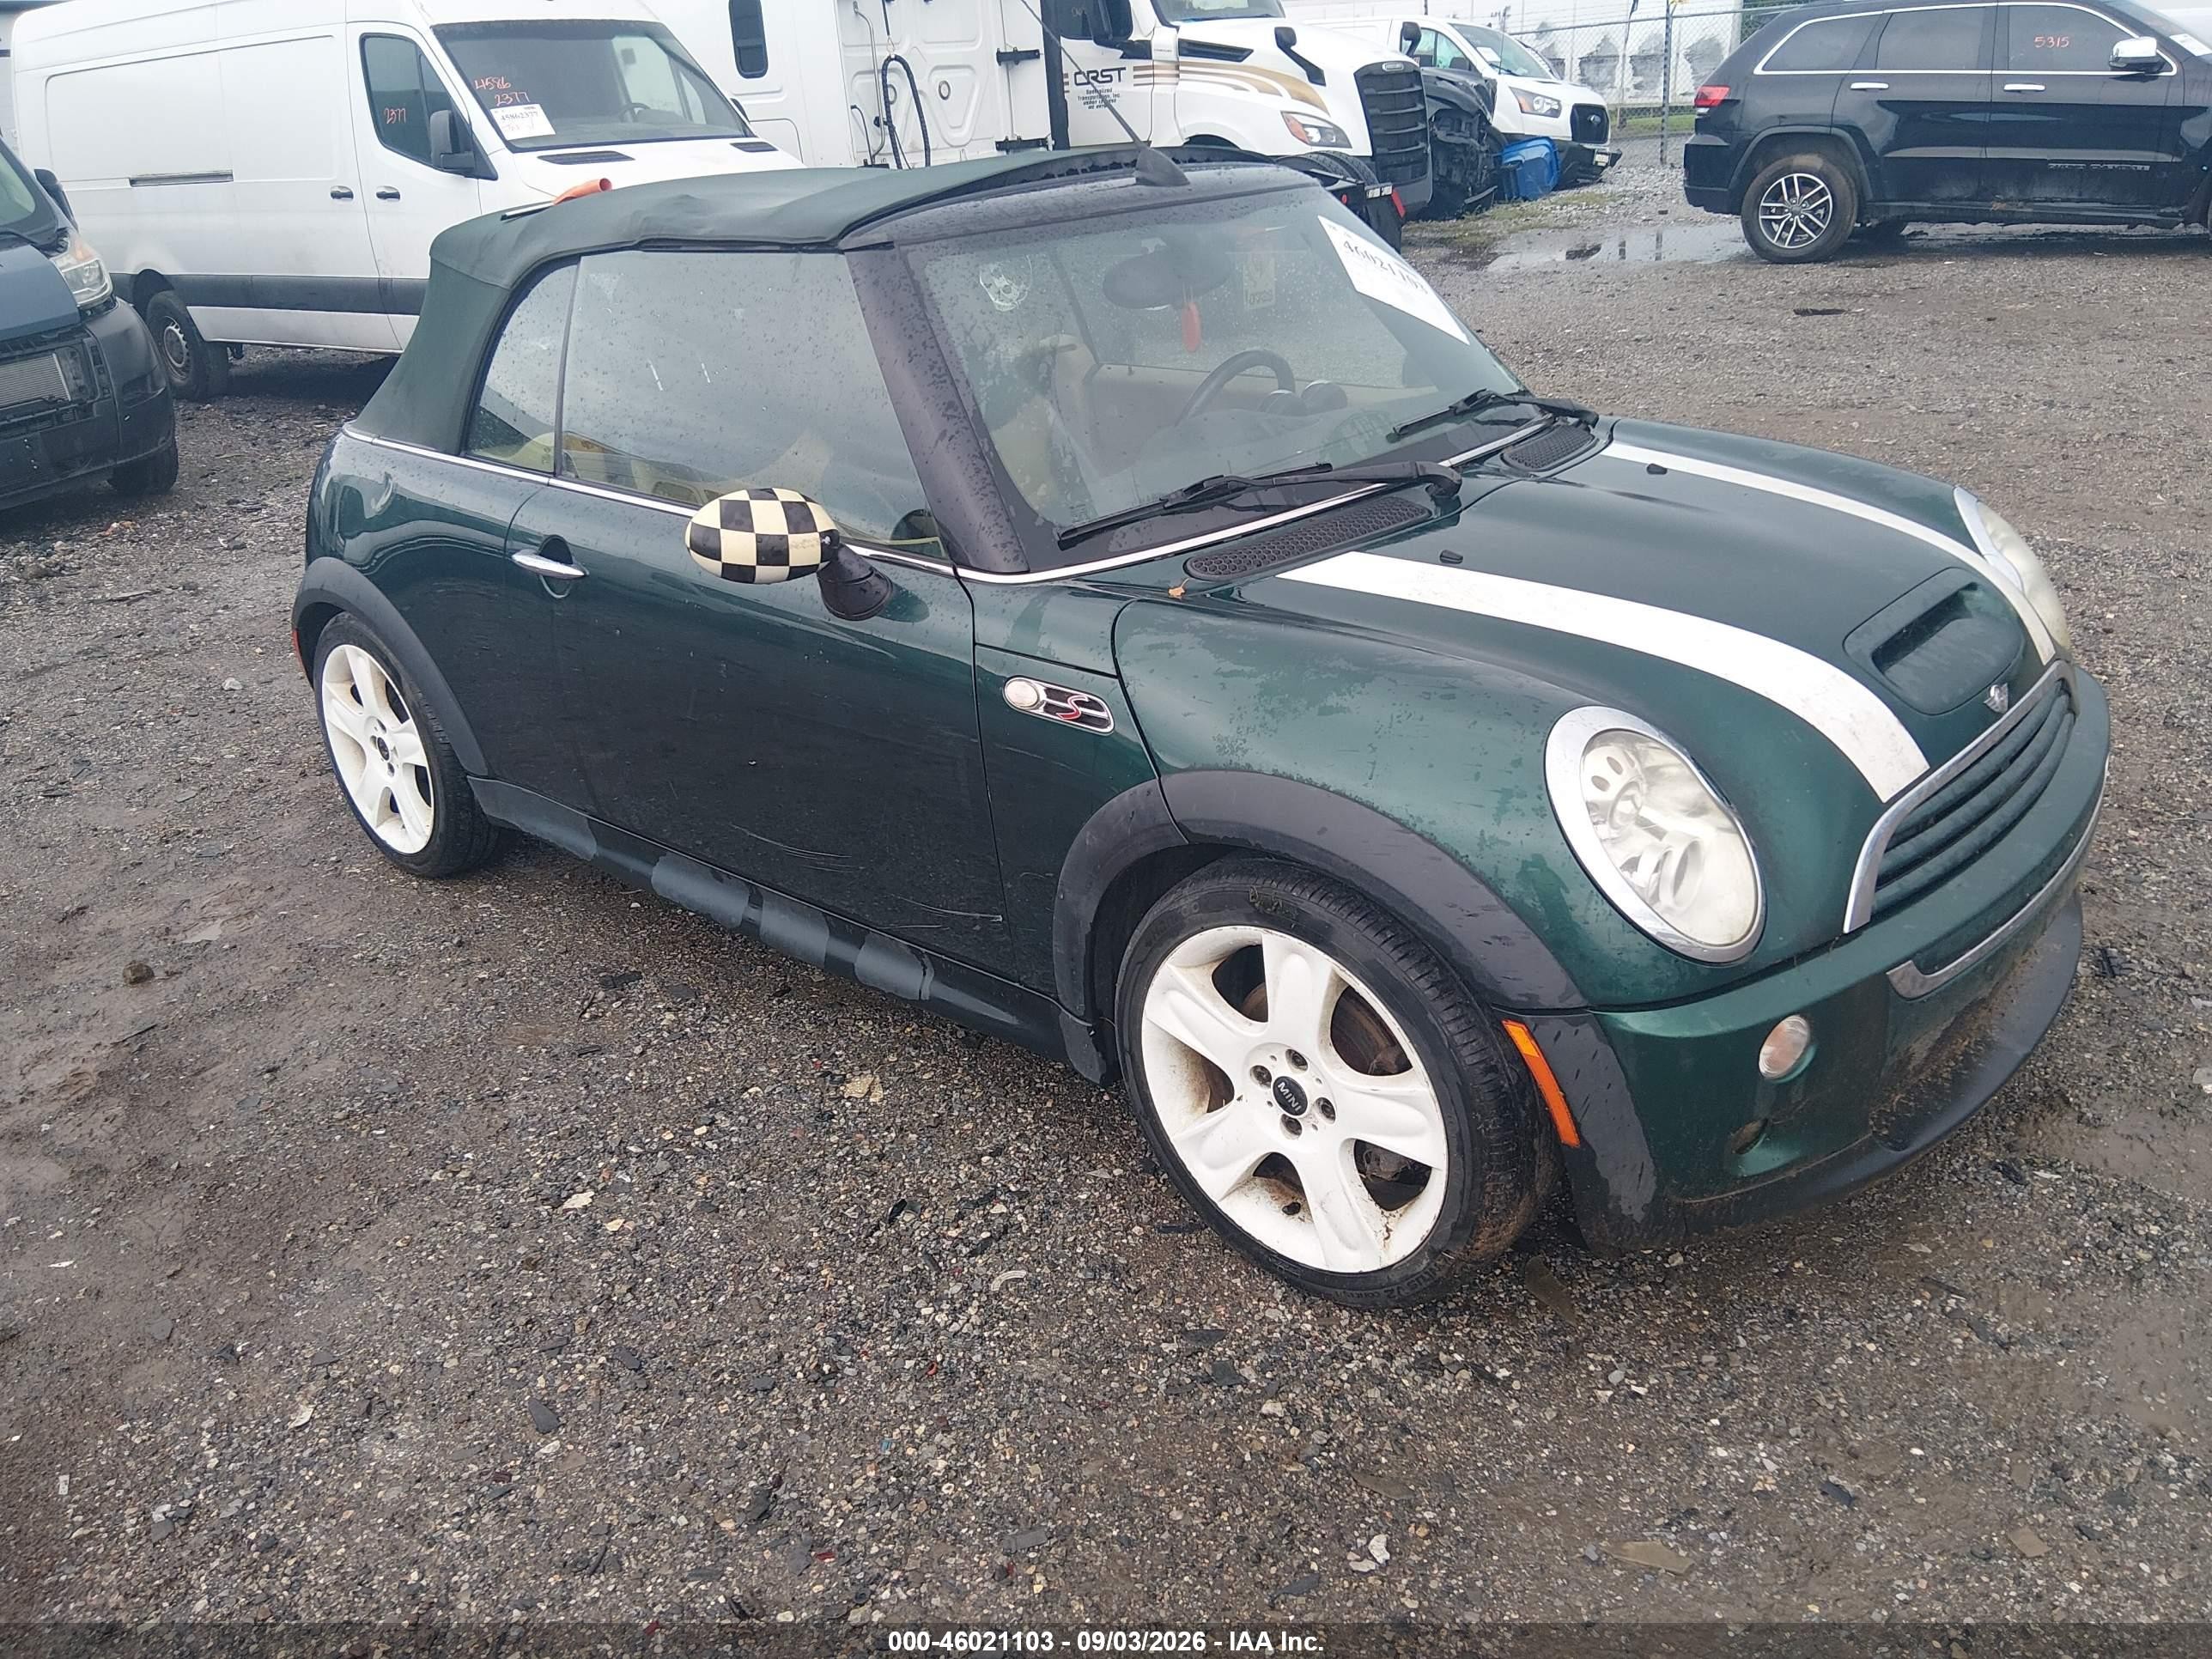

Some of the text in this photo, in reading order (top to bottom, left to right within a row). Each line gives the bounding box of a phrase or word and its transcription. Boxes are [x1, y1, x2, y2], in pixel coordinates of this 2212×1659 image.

[2033, 36, 2069, 48] 5315
[474, 76, 512, 90] 4586
[1073, 67, 1127, 86] CRST
[494, 90, 532, 106] 2377
[1277, 1082, 1302, 1112] MINI
